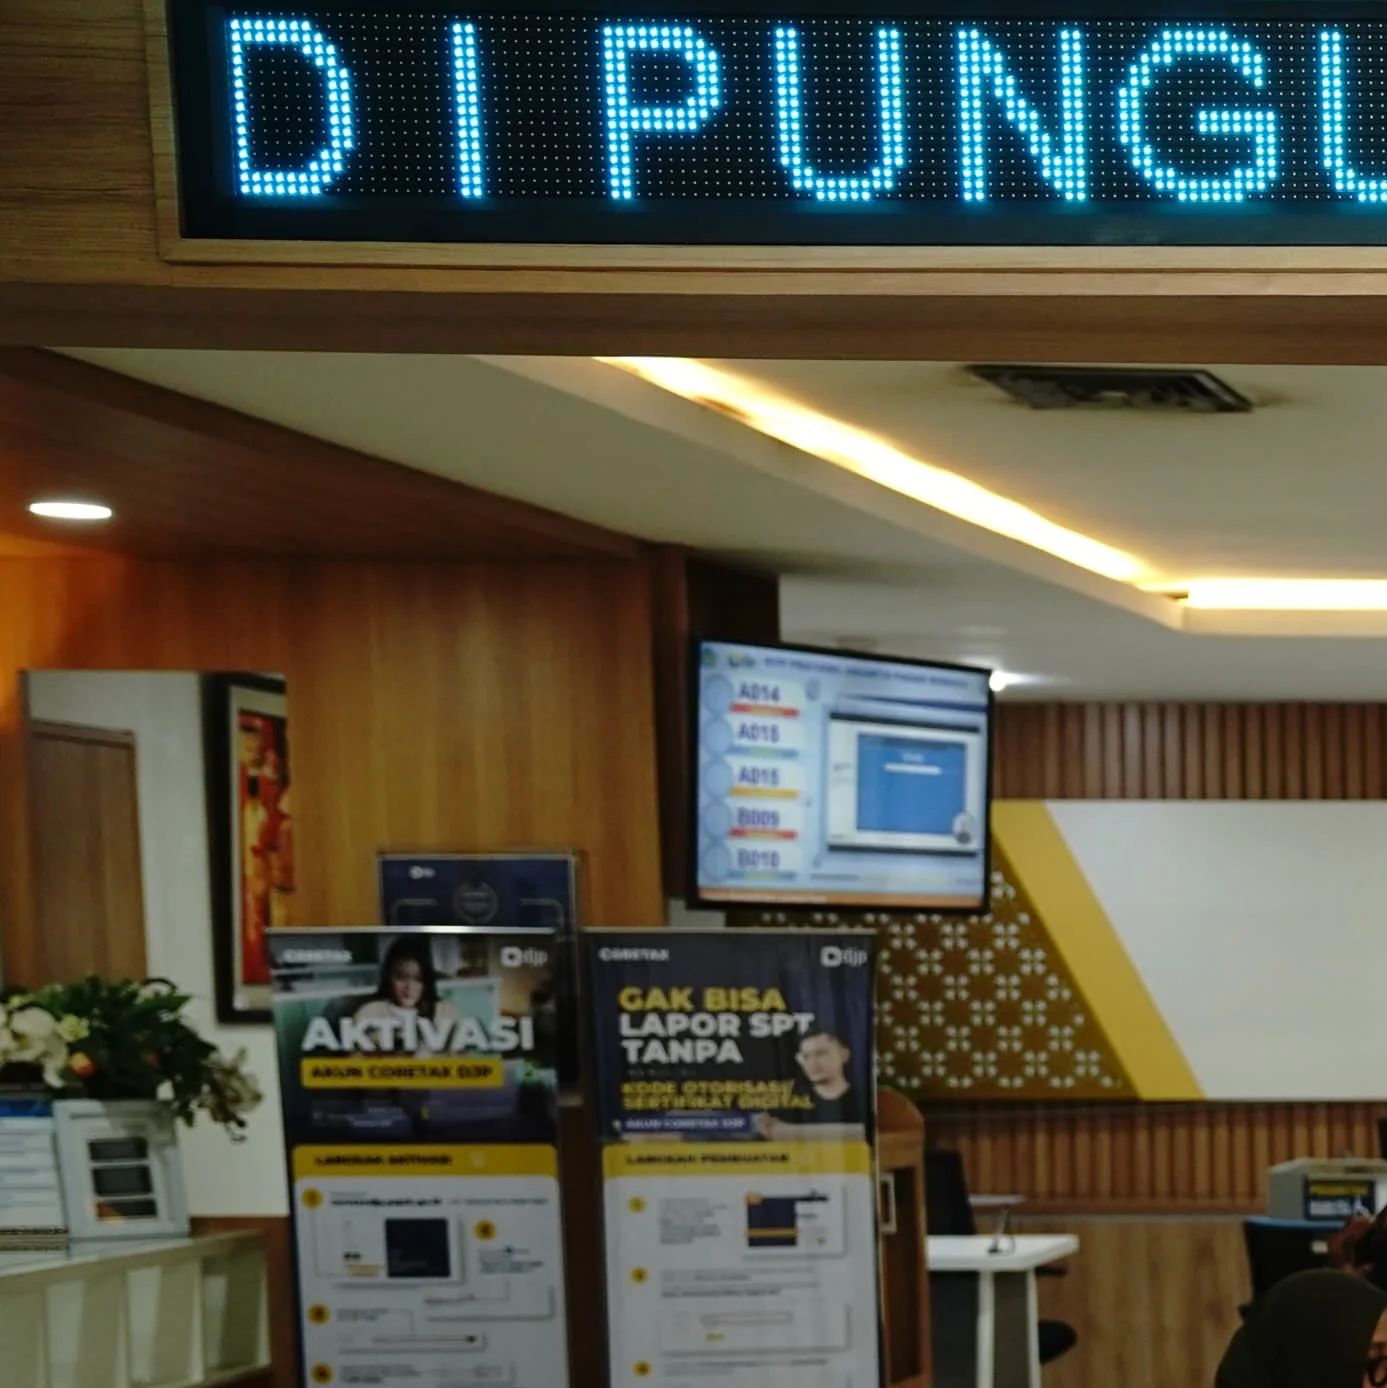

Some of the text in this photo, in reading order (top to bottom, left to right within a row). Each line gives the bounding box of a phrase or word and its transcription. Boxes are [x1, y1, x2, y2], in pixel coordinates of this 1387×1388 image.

[619, 986, 786, 1012] GAK BISA
[301, 1016, 534, 1051] AKTIVASI
[619, 1012, 815, 1038] LAPOR SPT
[621, 1038, 744, 1064] TANPA
